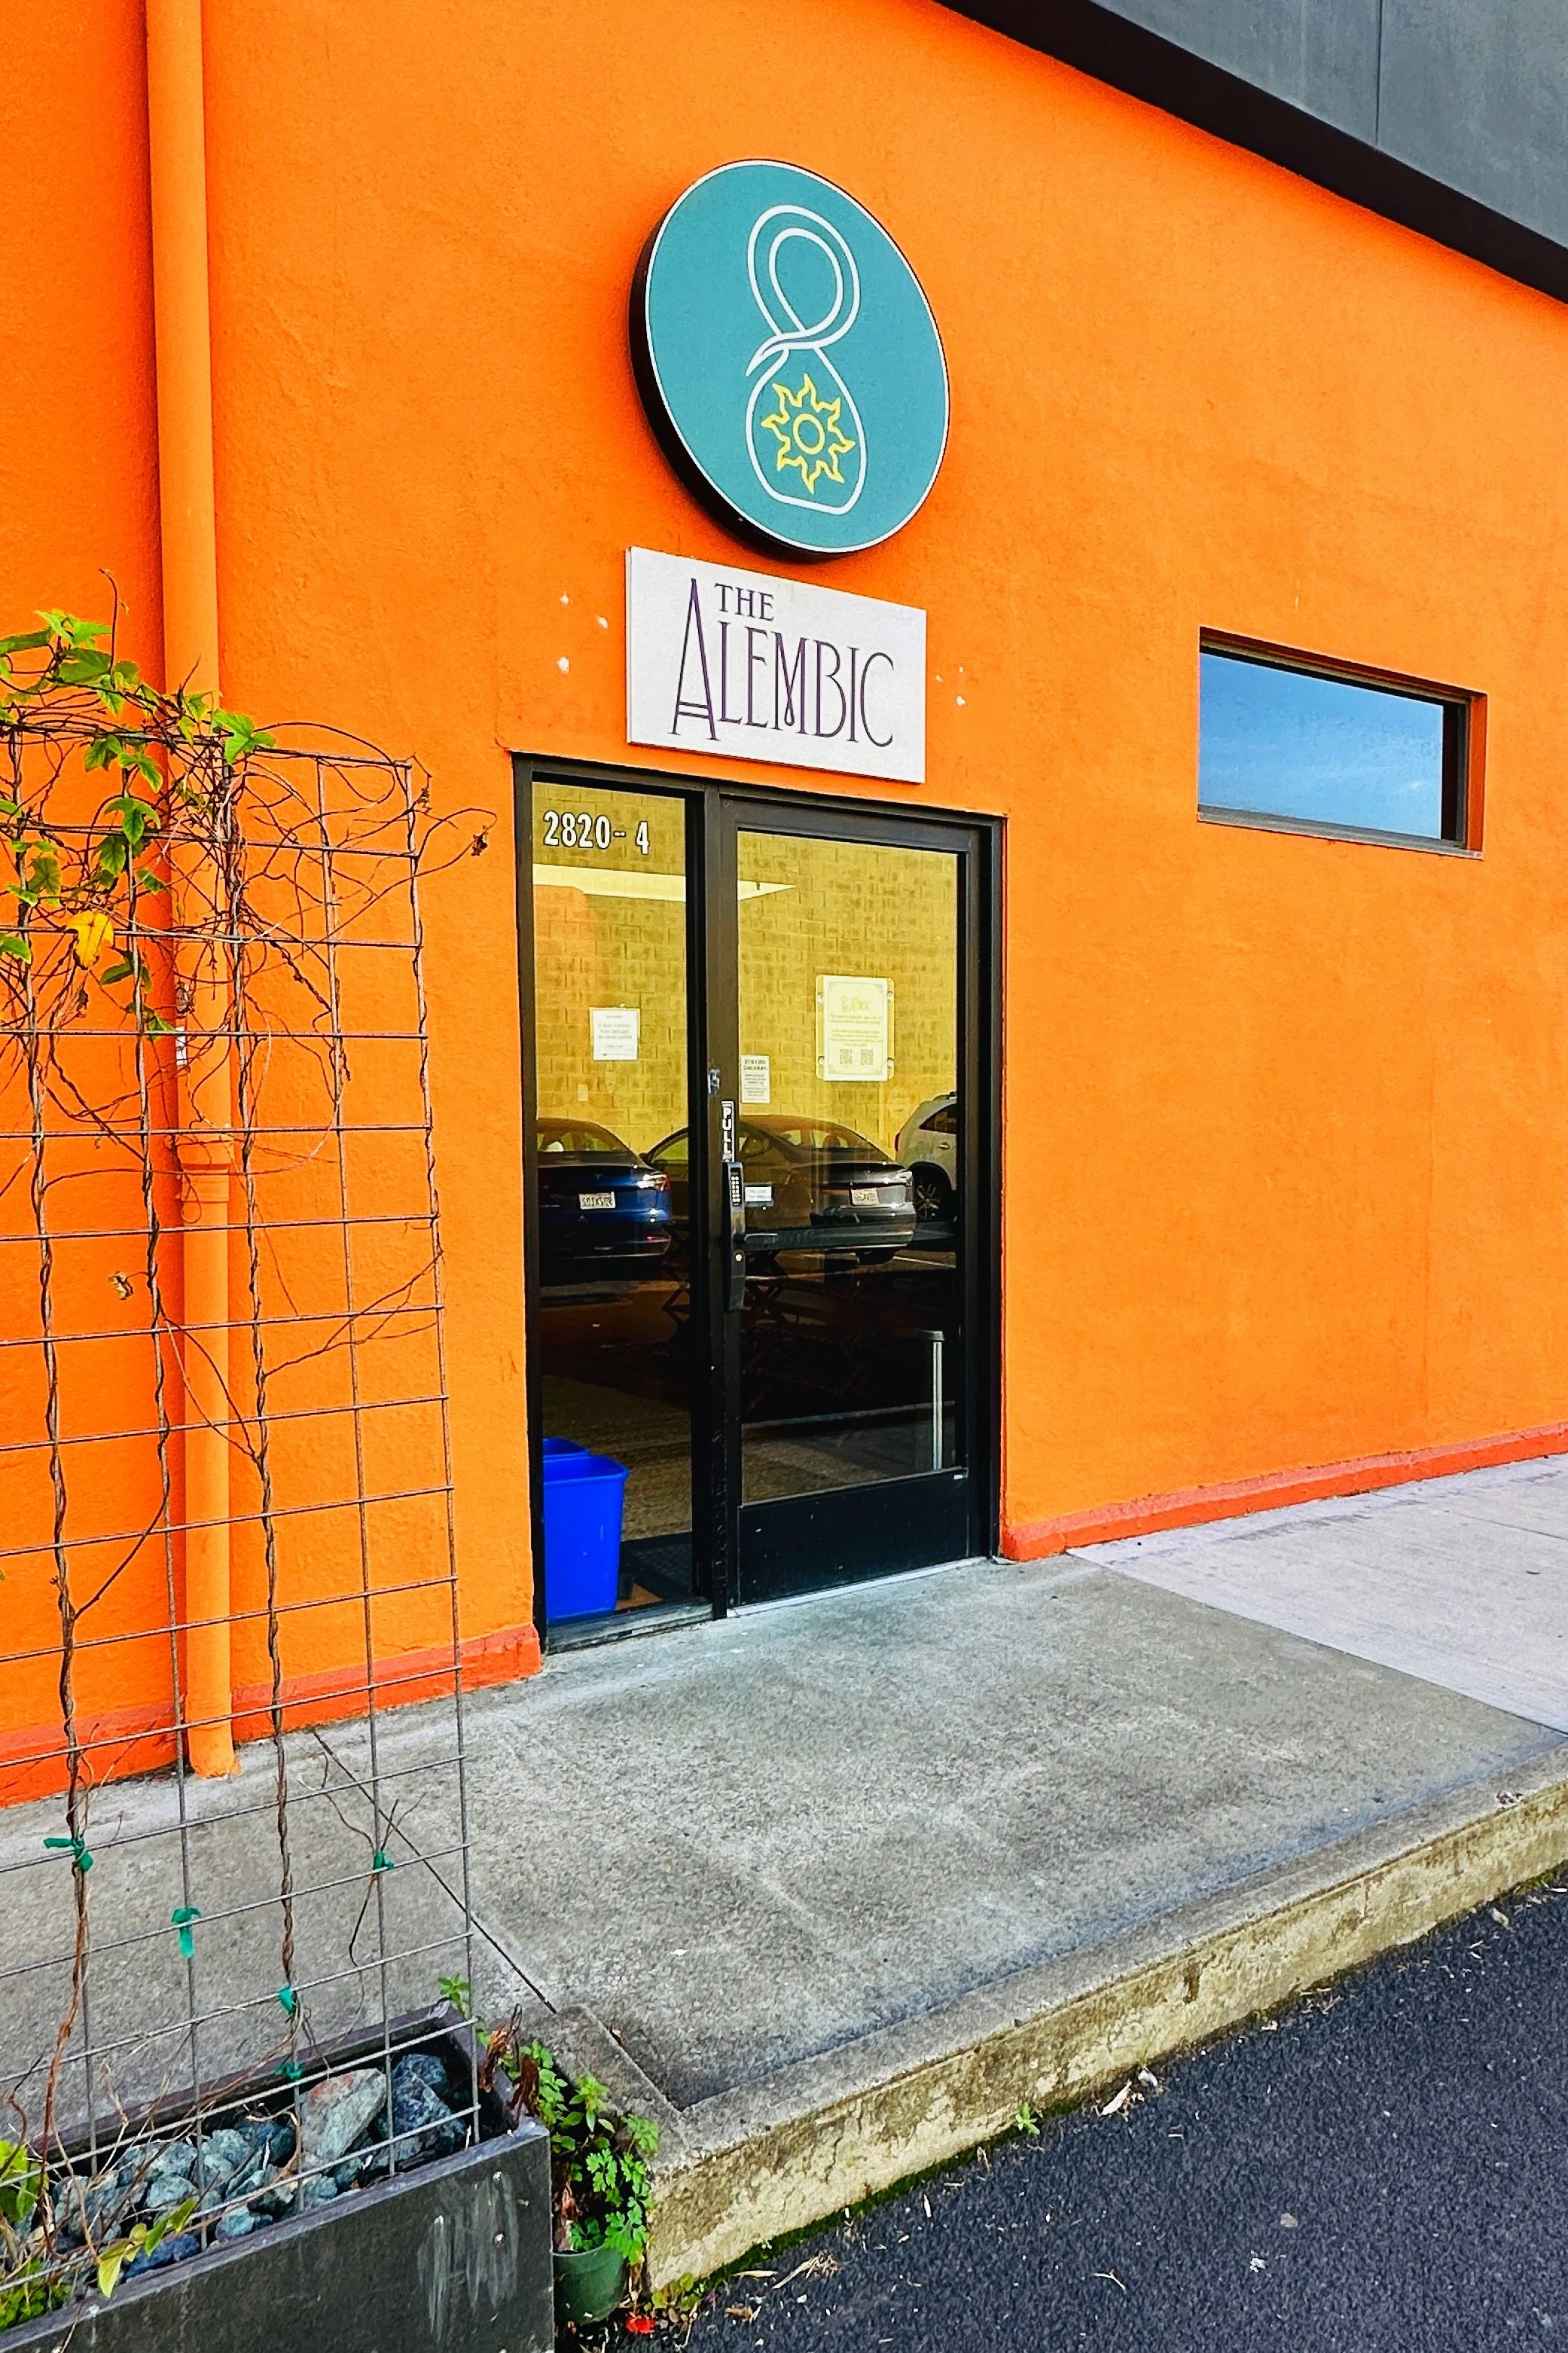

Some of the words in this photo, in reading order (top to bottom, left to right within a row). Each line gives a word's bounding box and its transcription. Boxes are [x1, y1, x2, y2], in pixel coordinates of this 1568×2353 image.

[715, 583, 774, 622] THE
[667, 578, 894, 747] ALEMBIC
[635, 820, 650, 855] 4
[722, 1106, 732, 1155] PULL
